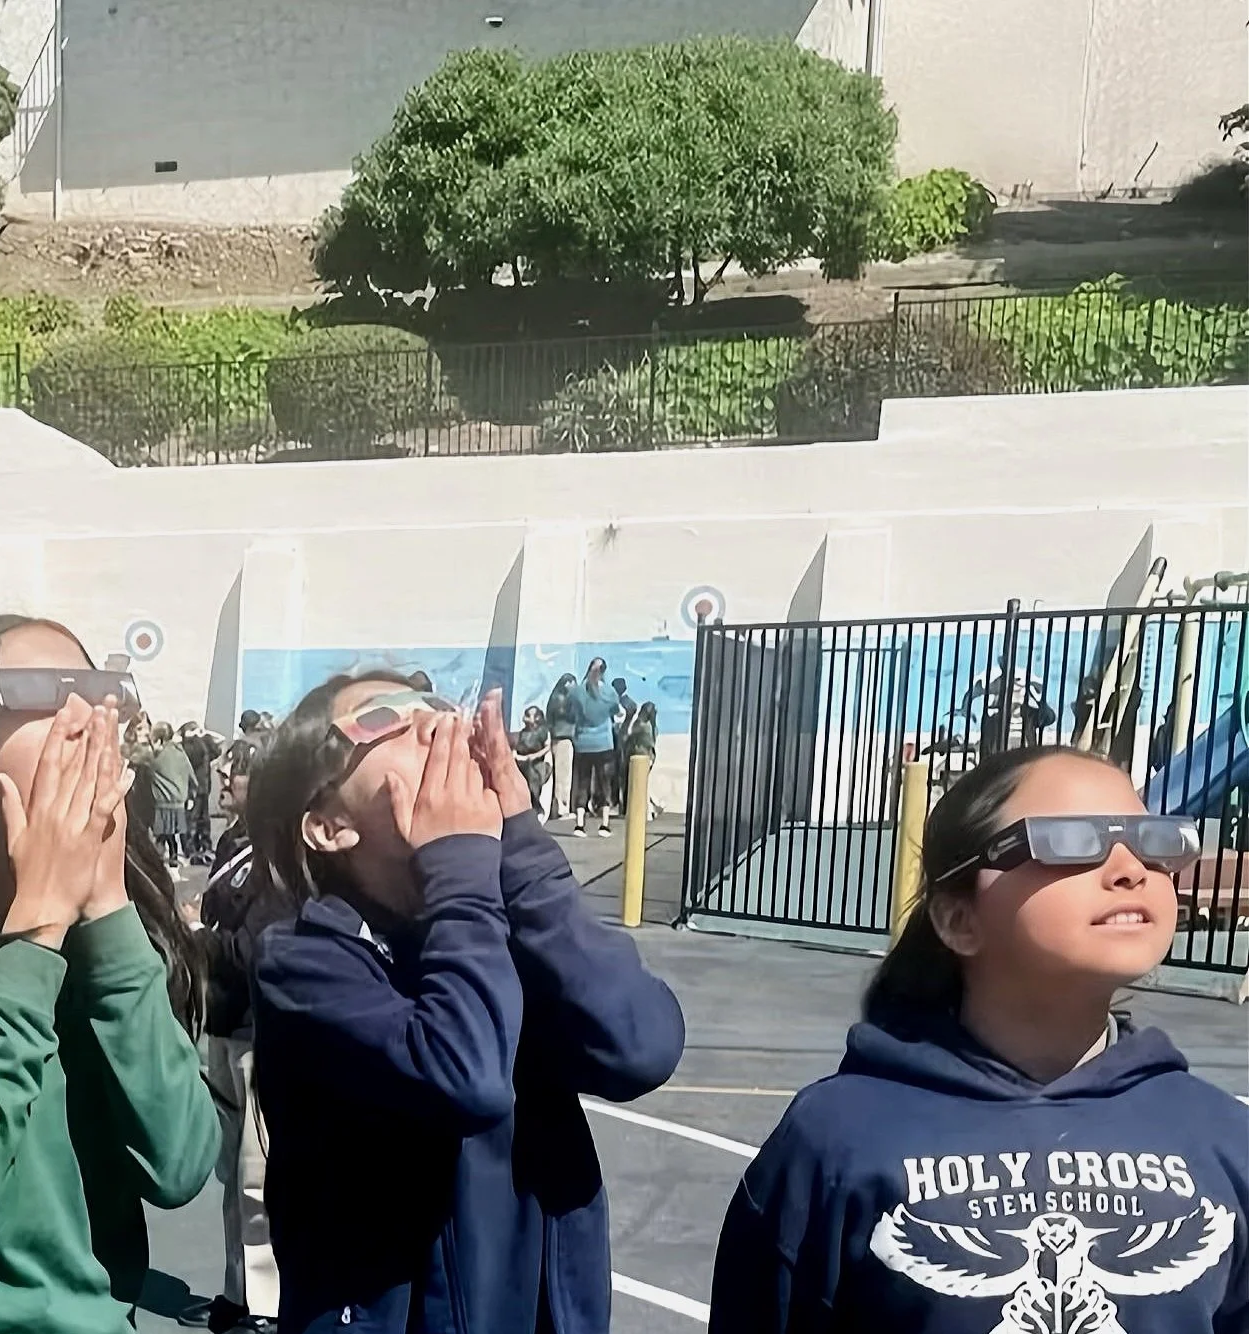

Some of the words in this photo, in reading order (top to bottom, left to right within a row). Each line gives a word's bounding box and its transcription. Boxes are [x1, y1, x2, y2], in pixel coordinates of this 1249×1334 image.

[903, 1151, 1032, 1204] HOLY
[1047, 1150, 1196, 1199] CROSS
[967, 1191, 1038, 1220] STEM
[1044, 1190, 1145, 1217] SCHOOL
